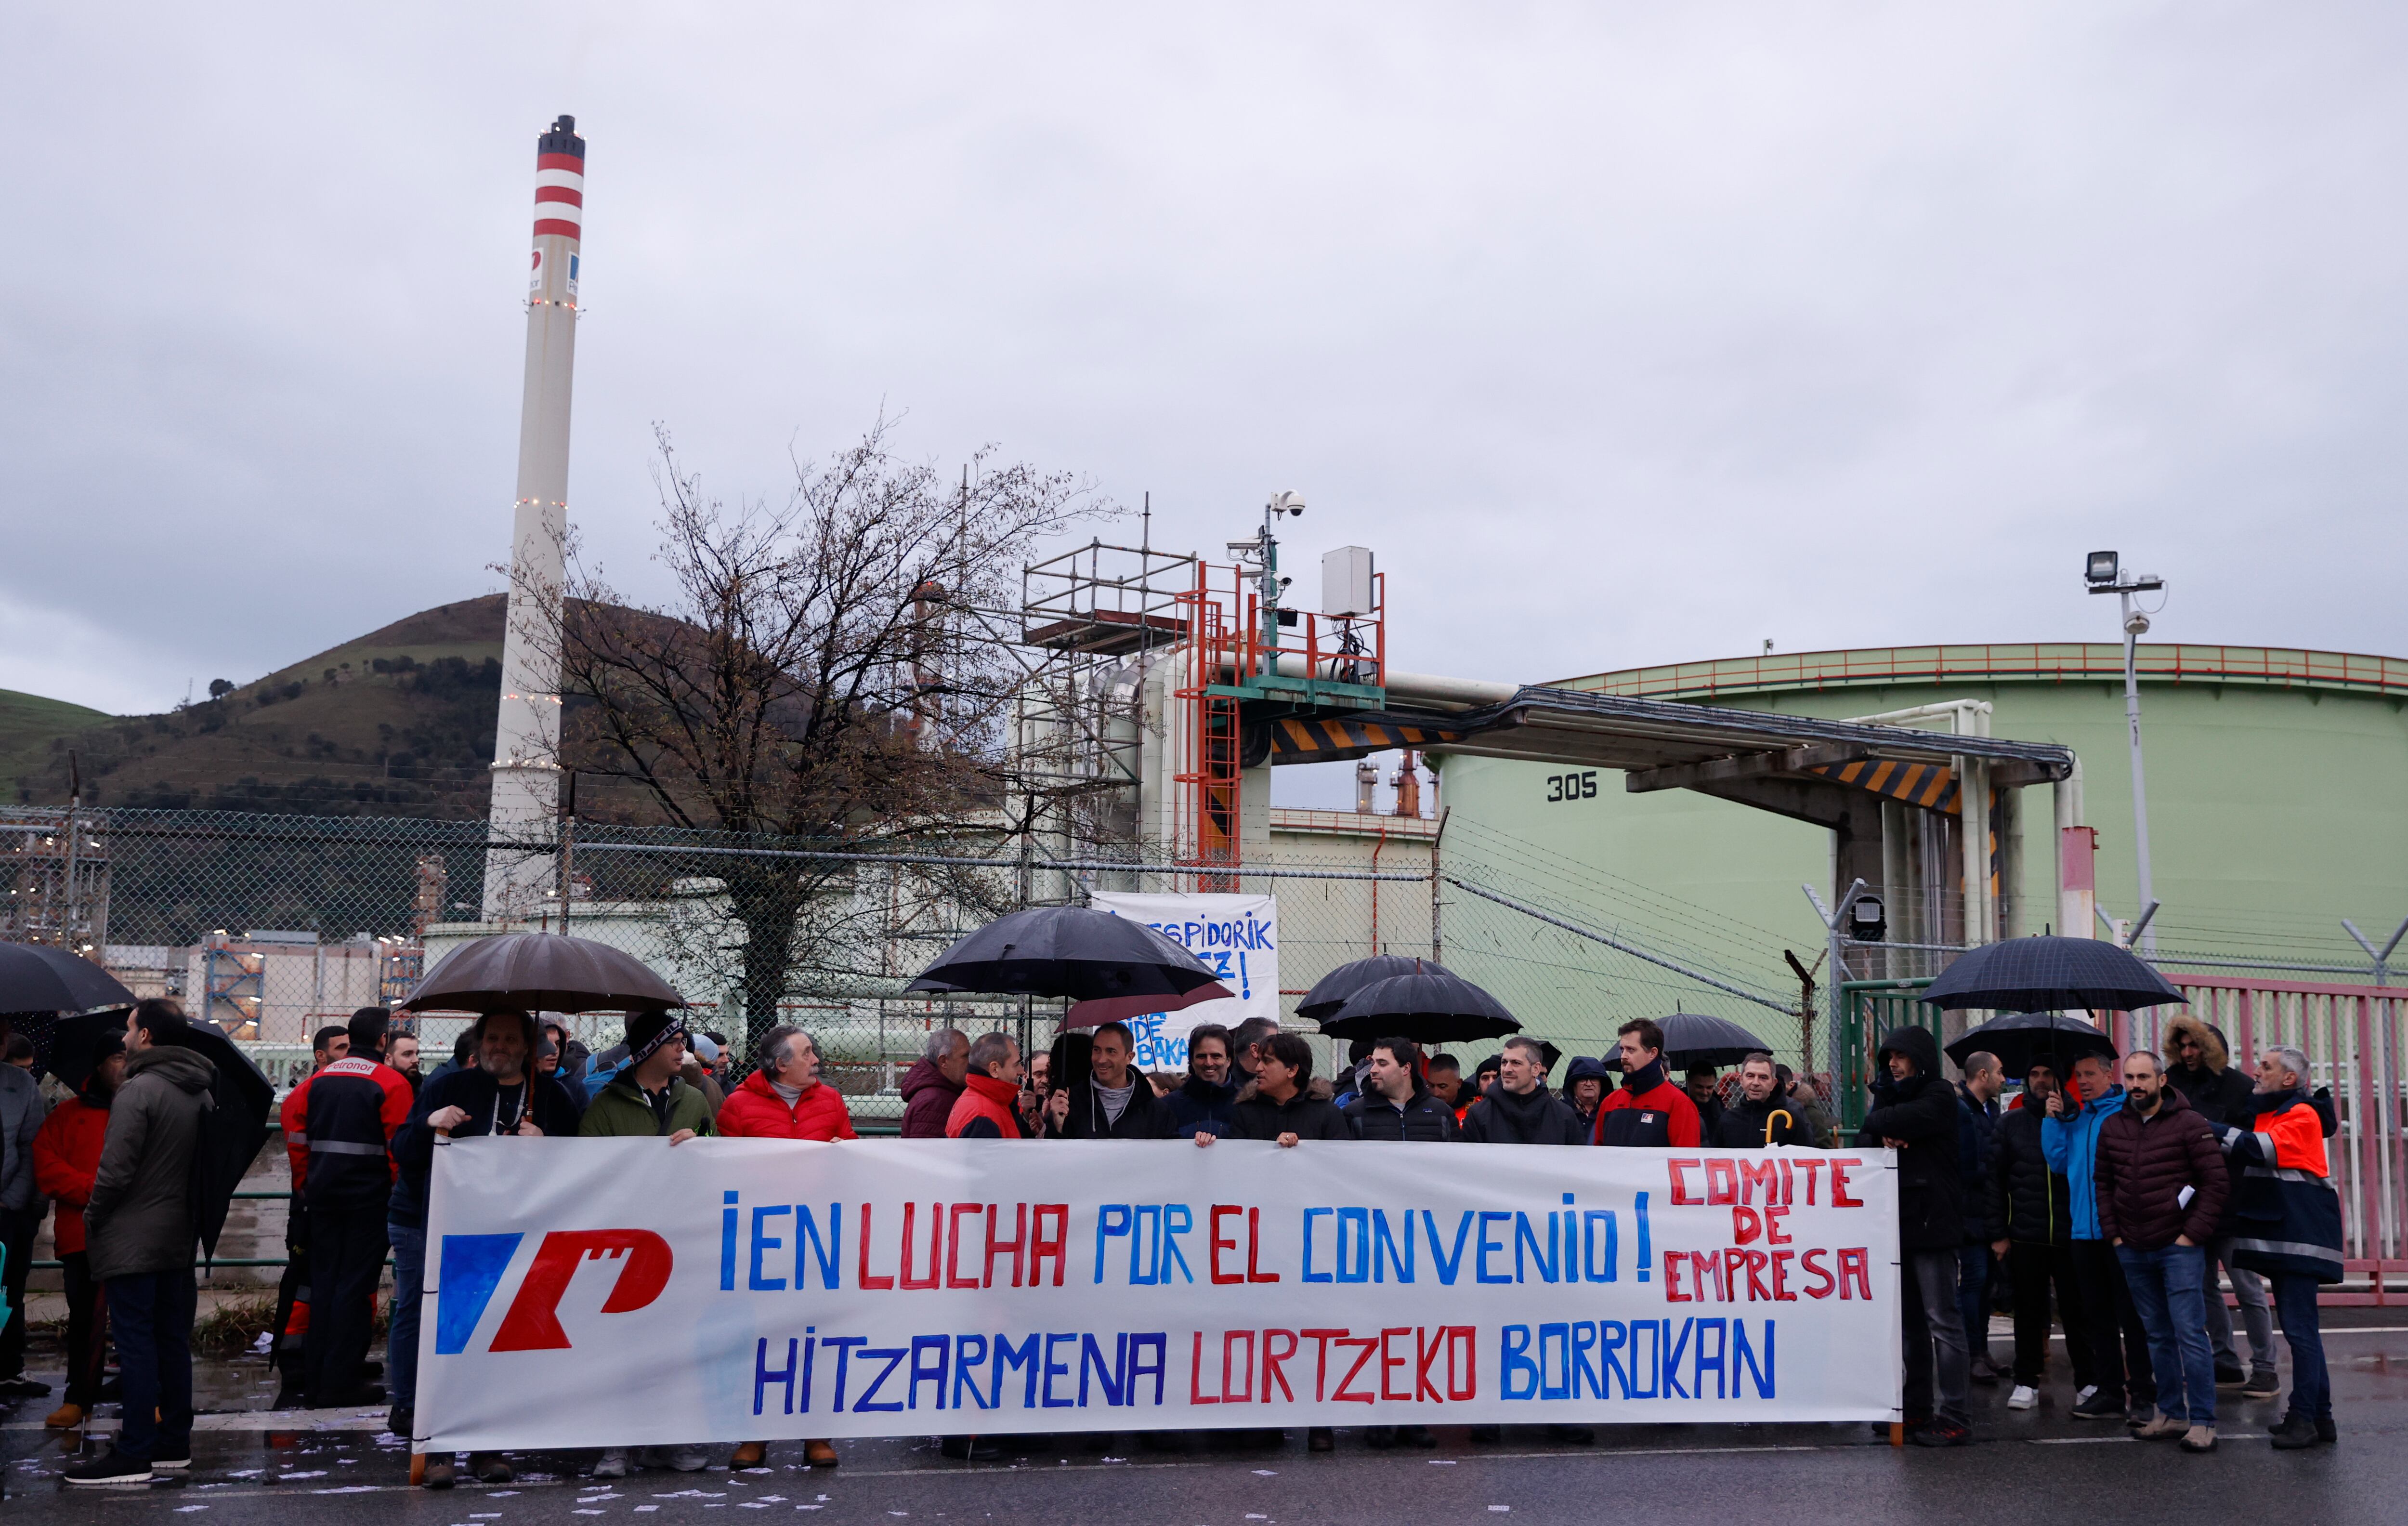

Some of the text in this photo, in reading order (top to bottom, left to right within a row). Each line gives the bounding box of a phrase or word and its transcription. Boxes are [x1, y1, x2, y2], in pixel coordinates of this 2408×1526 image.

[1547, 771, 1597, 802] 305
[1147, 911, 1274, 950] SPIDORIK
[327, 1061, 374, 1072] Petronor
[1136, 1037, 1189, 1066] BAKA
[1667, 1158, 1864, 1208] COMITE
[1732, 1205, 1792, 1245] DE
[859, 1202, 1069, 1290] LUCHA
[1094, 1203, 1194, 1285] POR
[1210, 1205, 1280, 1285] EL
[1664, 1247, 1873, 1302] EMPRESA
[753, 1316, 1776, 1415] HITZARMENA LORTZEKO BORROKAN
